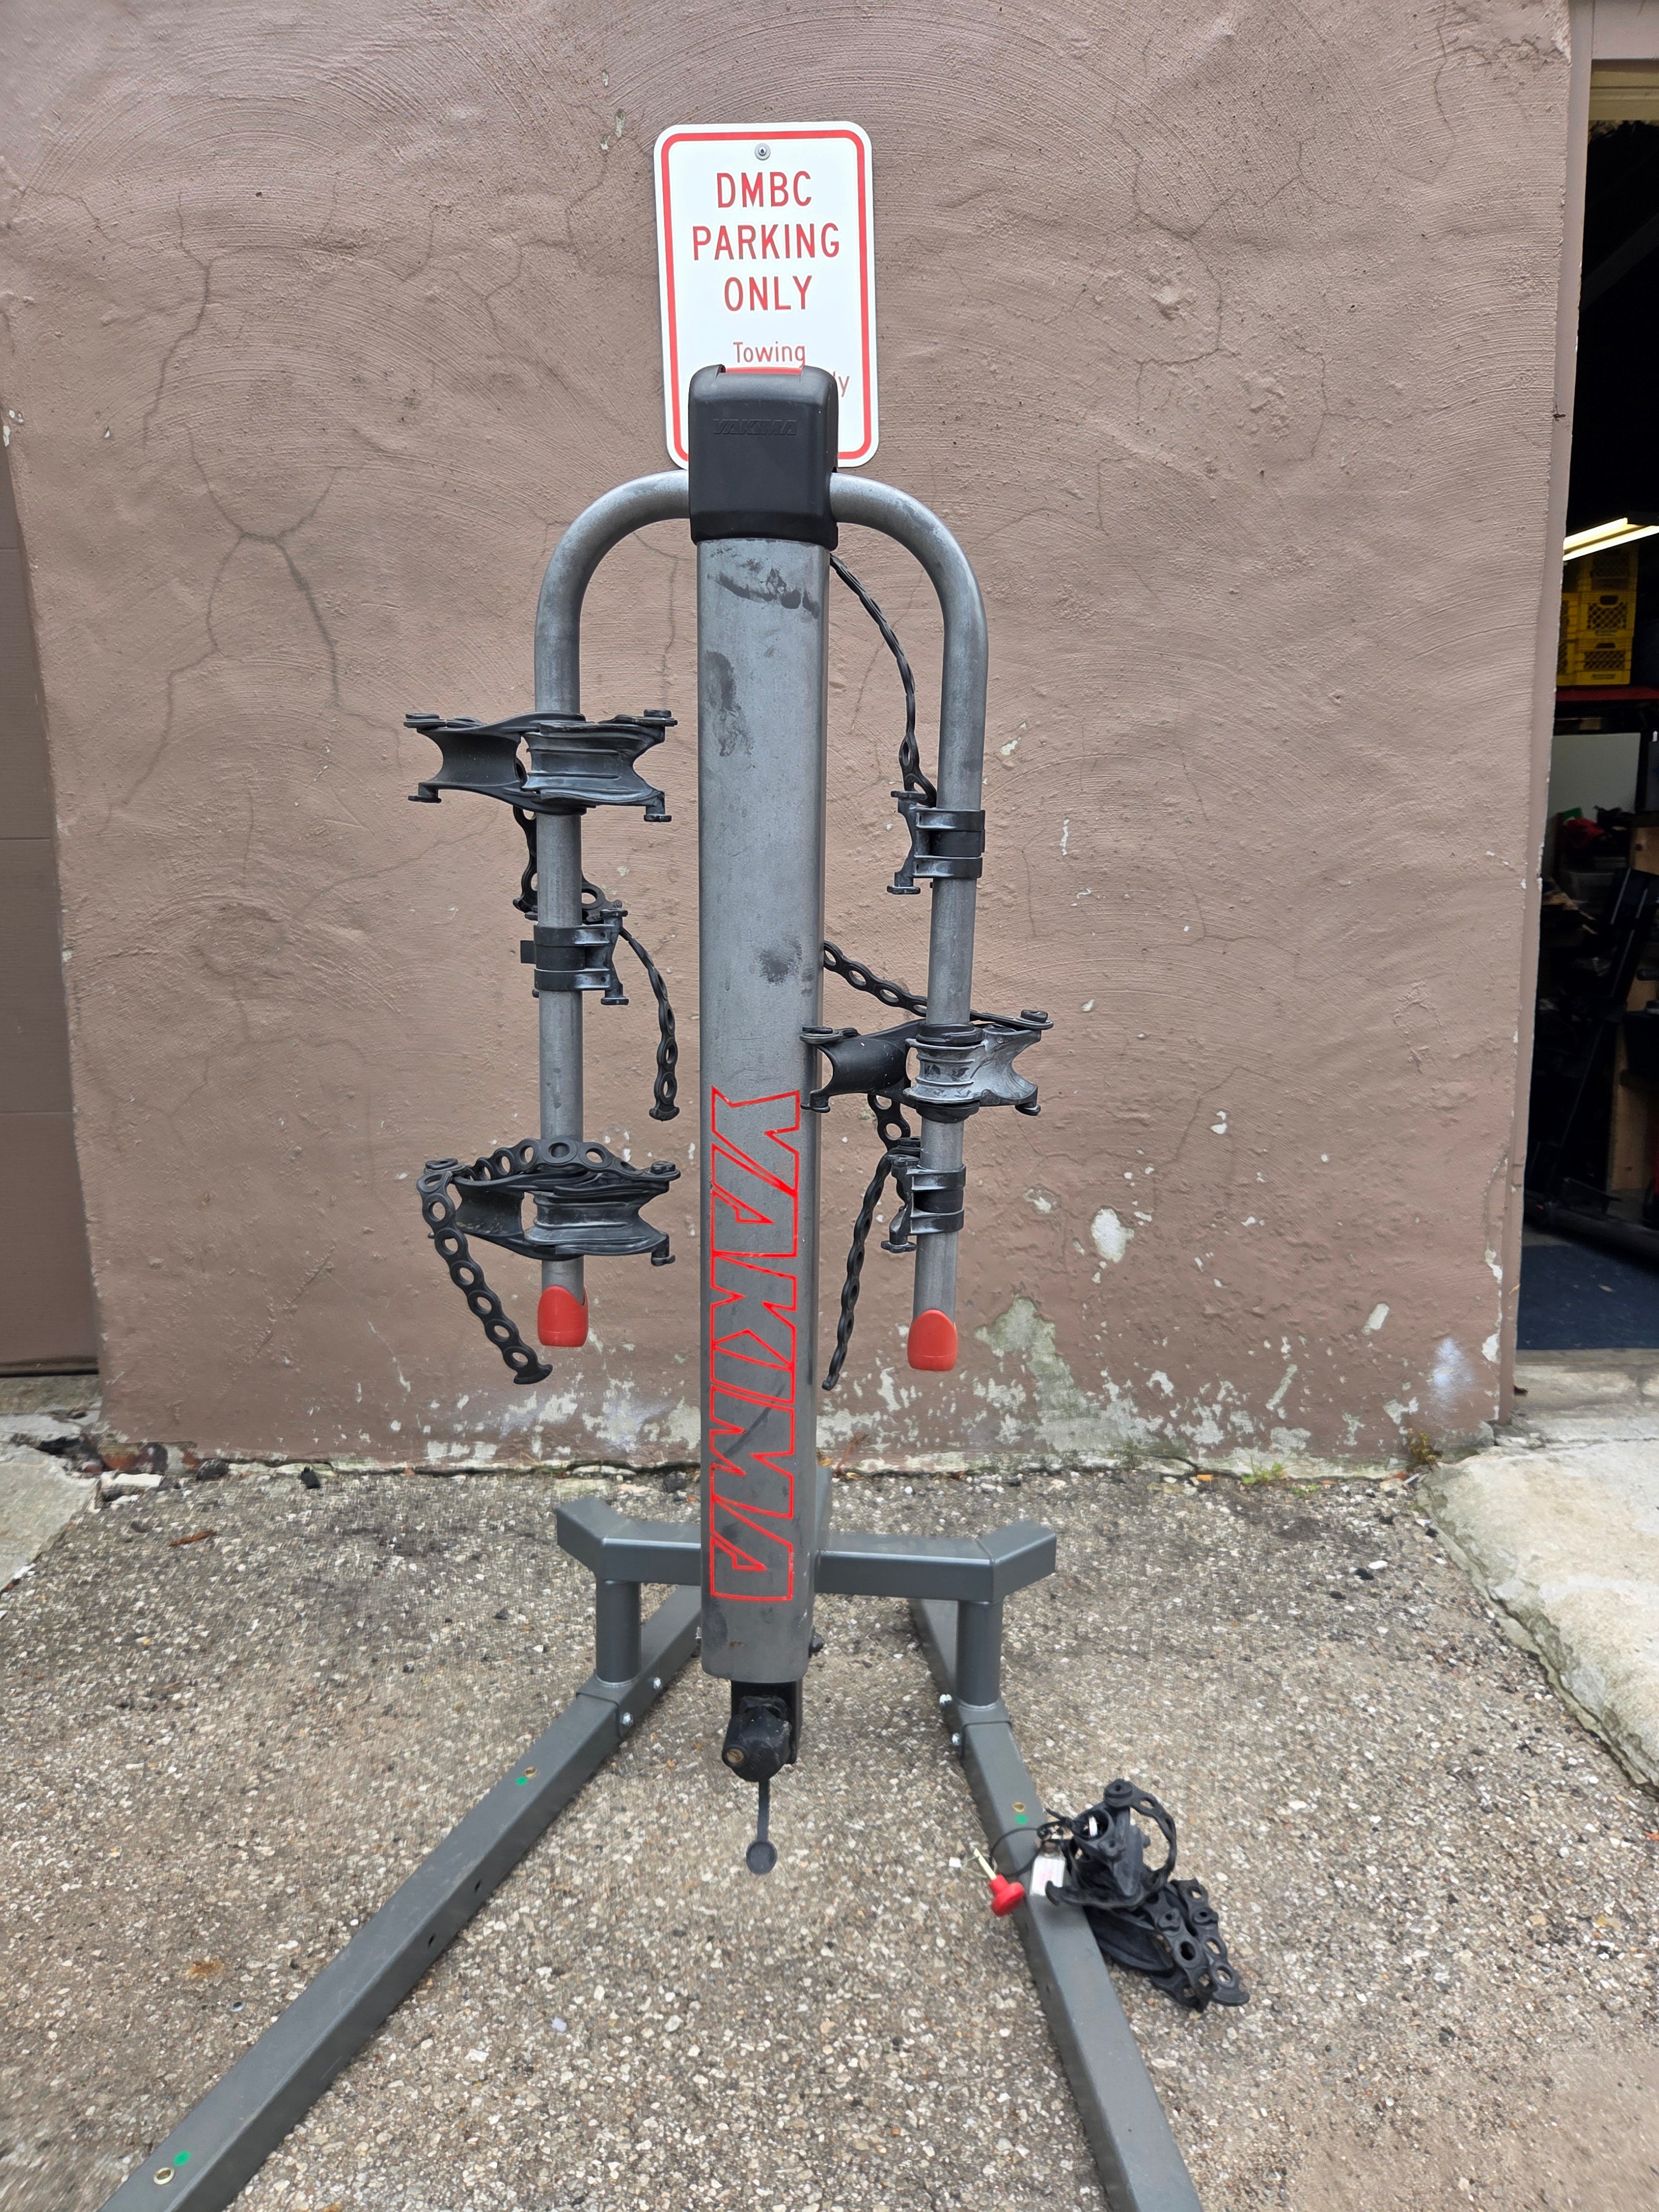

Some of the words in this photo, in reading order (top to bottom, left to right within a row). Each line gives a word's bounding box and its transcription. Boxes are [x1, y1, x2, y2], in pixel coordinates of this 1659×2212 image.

[717, 170, 811, 208] DMBC
[692, 222, 839, 260] PARKING
[724, 275, 812, 311] ONLY
[732, 340, 806, 366] Towing
[713, 419, 798, 436] YAKIMA
[711, 1086, 800, 1602] YAKIMA
